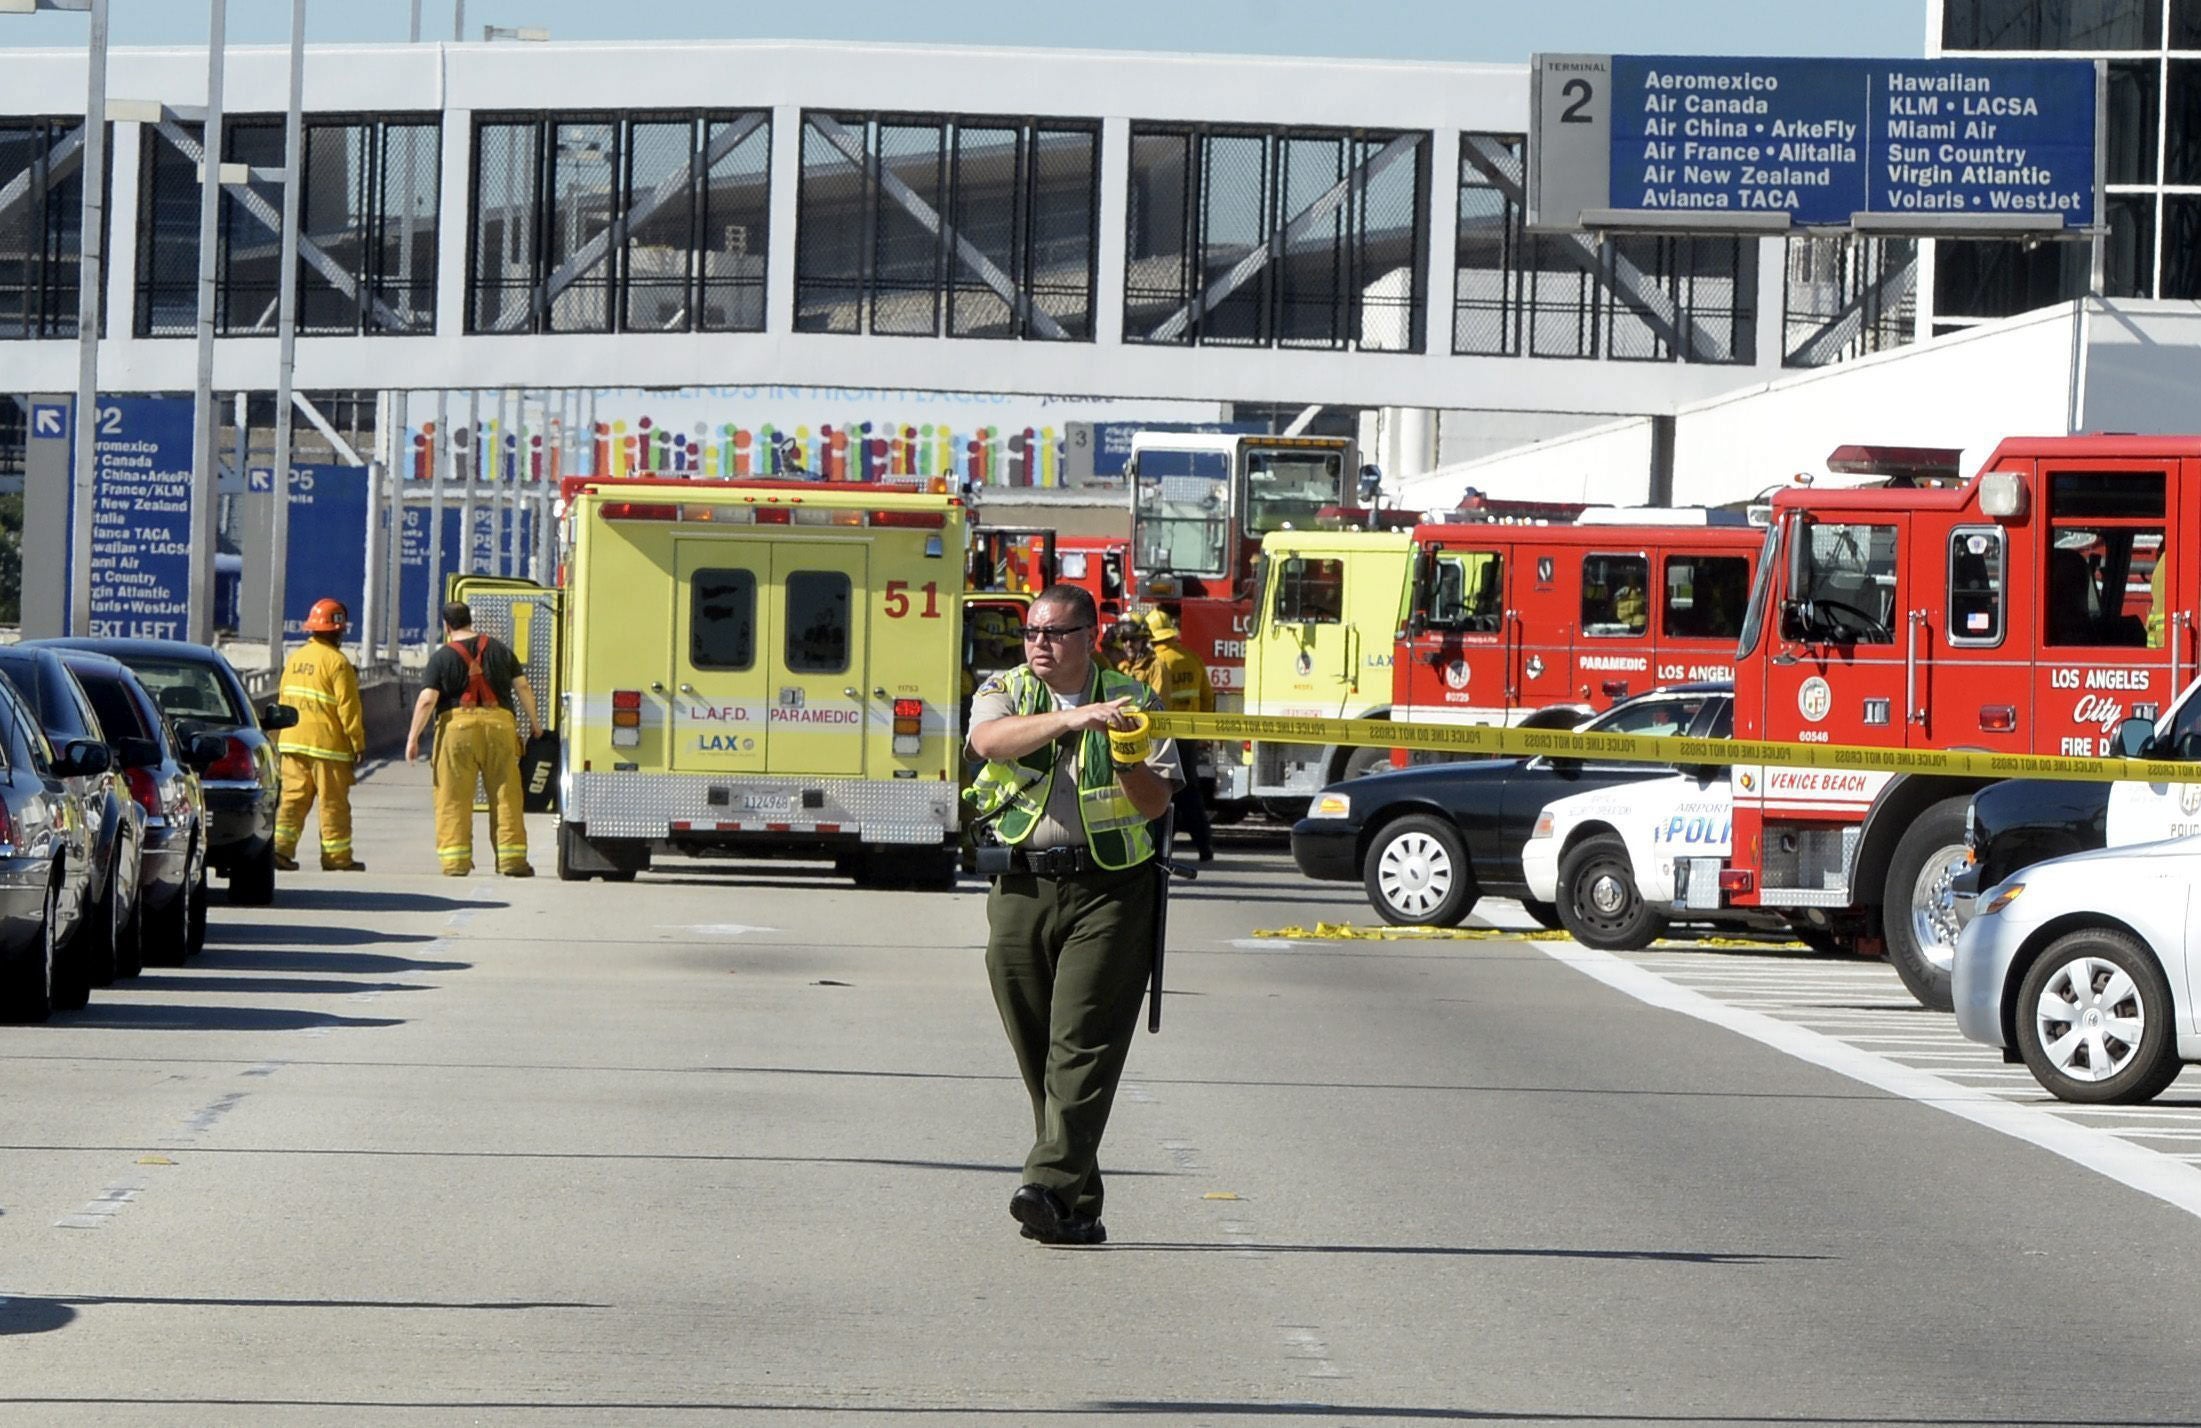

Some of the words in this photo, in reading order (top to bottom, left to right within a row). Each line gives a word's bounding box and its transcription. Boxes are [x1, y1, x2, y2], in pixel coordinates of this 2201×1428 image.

[1548, 62, 1606, 72] TERMINAL
[1644, 71, 1779, 92] Aeromexico
[1887, 72, 1991, 93] Hawaiian
[1560, 78, 1594, 123] 2
[1644, 94, 1676, 112] Air
[1684, 94, 1768, 114] Canada
[1889, 96, 1938, 116] KLM
[1963, 97, 2038, 116] LACSA
[1644, 118, 1676, 136] Air
[1684, 118, 1748, 137] China
[1771, 119, 1857, 142] ArkeFly
[1887, 120, 1956, 139] Miami
[1964, 121, 1997, 140] Air
[1643, 142, 1676, 160] Air
[1684, 142, 1760, 161] France
[1778, 143, 1857, 162] Alitalia
[1887, 143, 1930, 163] Sun
[1938, 144, 2026, 167] Country
[1643, 165, 1676, 184] Air
[1684, 166, 1731, 184] New
[1740, 167, 1830, 186] Zealand
[1887, 164, 1953, 187] Virgin
[1961, 165, 2052, 186] Atlantic
[1642, 188, 1729, 208] Avianca
[1738, 189, 1800, 209] TACA
[1887, 189, 1965, 210] Volaris
[1989, 190, 2081, 210] WestJet
[95, 440, 159, 454] romexico
[1075, 430, 1087, 447] 3
[102, 454, 153, 468] Canada
[101, 483, 186, 498] France/KLM
[101, 498, 130, 510] New
[134, 499, 188, 512] Zealand
[95, 513, 126, 525] talia
[93, 527, 130, 540] ianca
[134, 527, 171, 541] TACA
[92, 541, 137, 554] waiian
[91, 556, 117, 568] ami
[120, 556, 140, 569] Air
[104, 570, 157, 587] Country
[91, 585, 114, 599] gin
[117, 585, 170, 599] Atlantic
[884, 580, 941, 619] 51
[91, 600, 122, 612] laris
[131, 601, 188, 614] WestJet
[89, 620, 124, 637] EXT
[130, 621, 178, 639] LEFT
[292, 662, 315, 676] LAFD
[1368, 654, 1394, 667] LAX
[1579, 656, 1647, 671] PARAMEDIC
[1211, 668, 1231, 686] 63
[1657, 665, 1685, 680] LOS
[1688, 666, 1735, 682] ANGEL
[2051, 668, 2080, 688] LOS
[2085, 669, 2150, 690] ANGELES
[691, 706, 750, 721] L.A.F.D.
[770, 708, 859, 724] PARAMEDIC
[2073, 694, 2122, 733] City
[698, 735, 738, 751] LAX
[2060, 737, 2093, 756] FIRE
[1770, 772, 1818, 790] VENICE
[1821, 774, 1867, 792] BEACH
[1675, 802, 1730, 814] AIRPORT
[1665, 815, 1732, 844] POLI
[2170, 823, 2200, 838] POLIC
